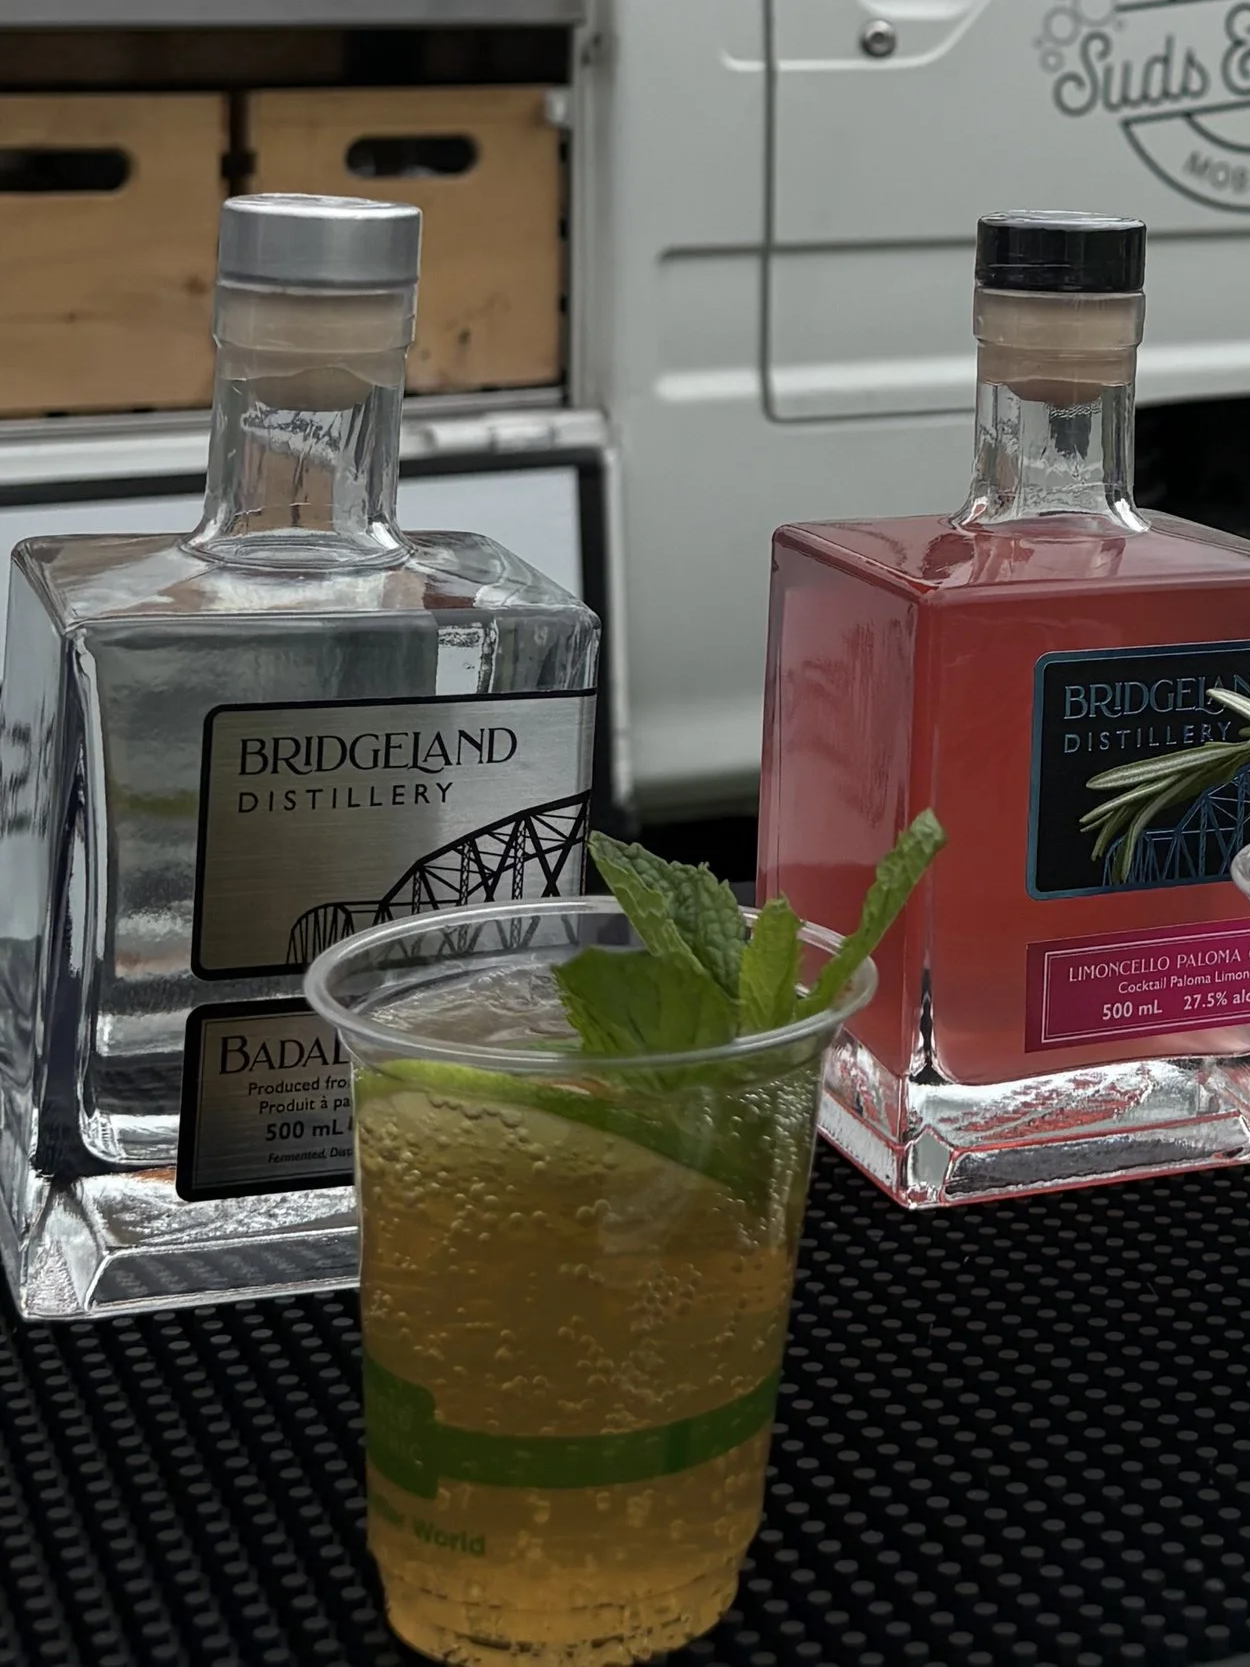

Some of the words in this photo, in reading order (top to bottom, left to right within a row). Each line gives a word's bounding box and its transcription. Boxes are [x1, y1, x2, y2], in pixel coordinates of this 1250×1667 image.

[1053, 31, 1210, 117] Suds
[237, 726, 518, 776] BRIDGELAND
[1063, 721, 1233, 754] DISTILLERY
[237, 782, 455, 814] DISTILLERY
[1068, 956, 1170, 982] LIMONCELLO
[1177, 948, 1241, 970] PALOMA
[1118, 978, 1167, 995] Cocktail
[1170, 974, 1211, 988] Paloma
[1102, 1000, 1133, 1021] 500
[1138, 998, 1163, 1016] mL
[1183, 991, 1228, 1011] 27.5%
[248, 1076, 320, 1097] Produced
[325, 1075, 351, 1091] fro
[259, 1098, 316, 1115] Produit
[320, 1095, 329, 1110] à
[265, 1120, 305, 1142] 500
[312, 1118, 345, 1138] mL
[412, 1514, 486, 1557] World
